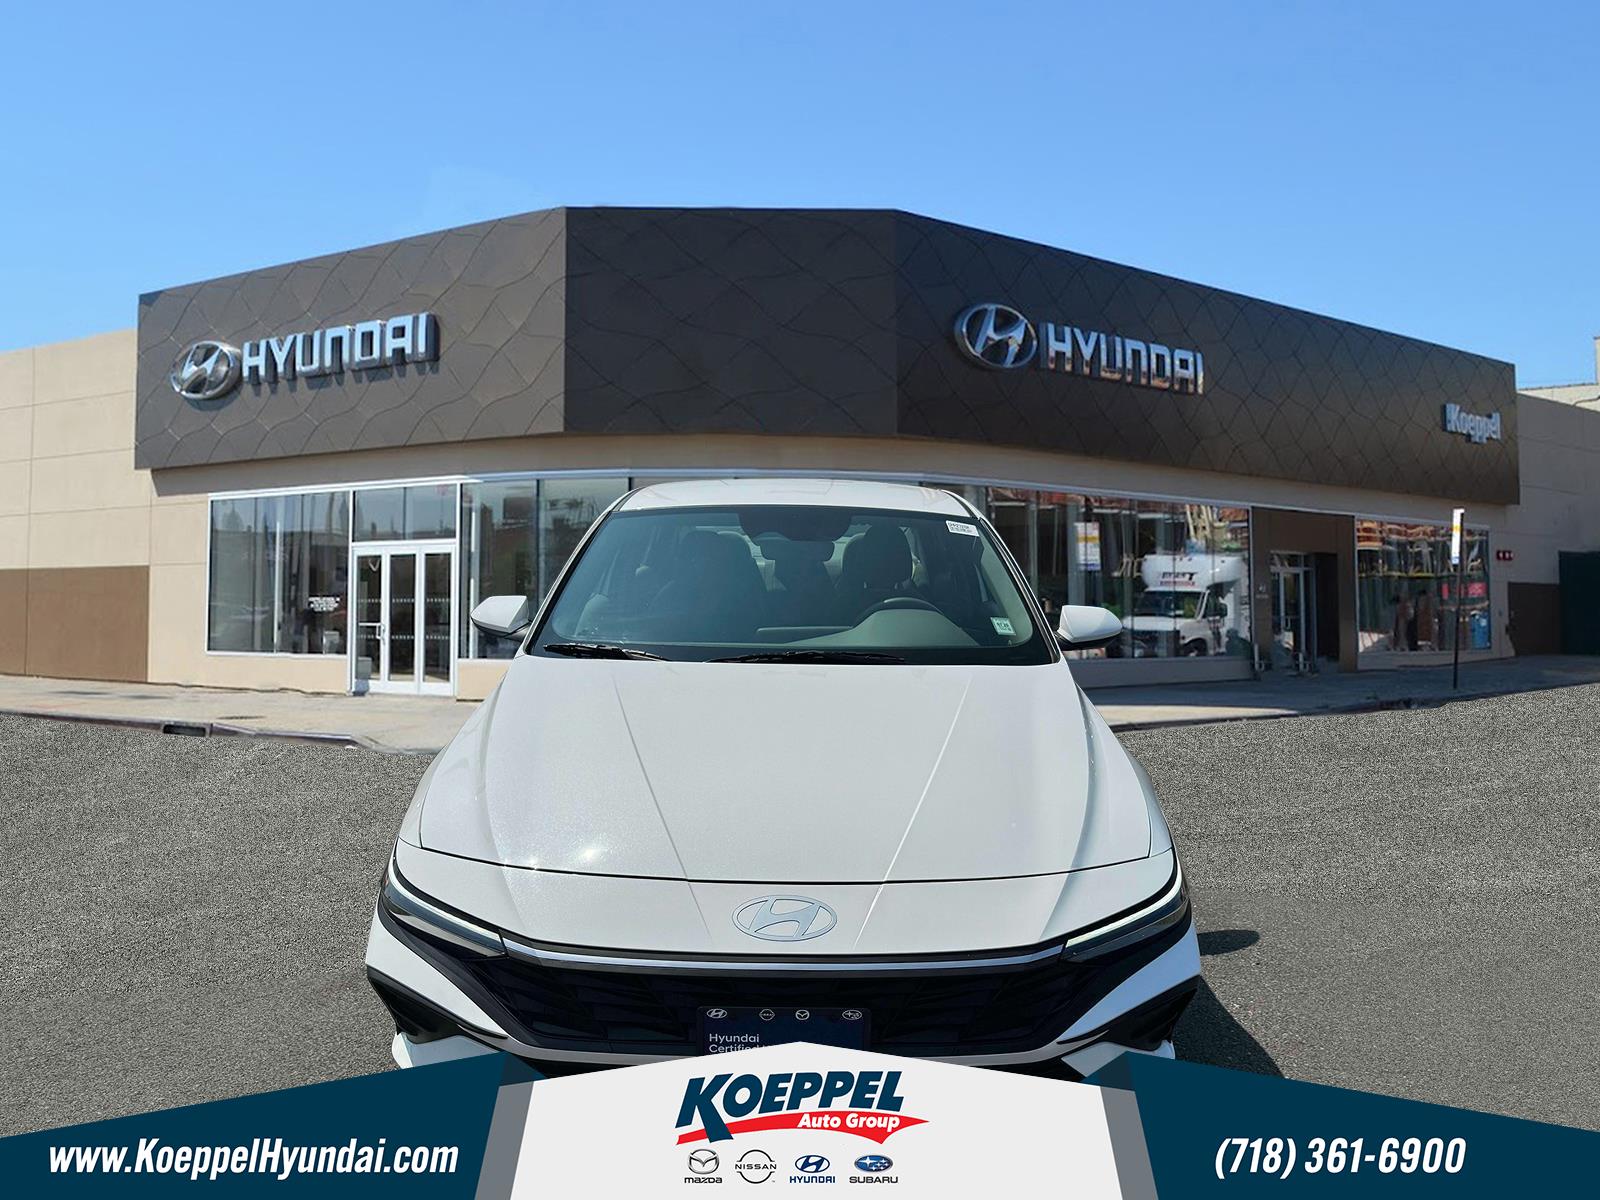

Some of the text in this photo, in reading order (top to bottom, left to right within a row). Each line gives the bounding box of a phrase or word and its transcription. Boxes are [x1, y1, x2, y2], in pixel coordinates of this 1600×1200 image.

[242, 312, 435, 384] HYUNDAI
[1046, 322, 1204, 394] HYUNDAI
[1446, 403, 1501, 443] Koeppel
[708, 1033, 760, 1044] Hyundai
